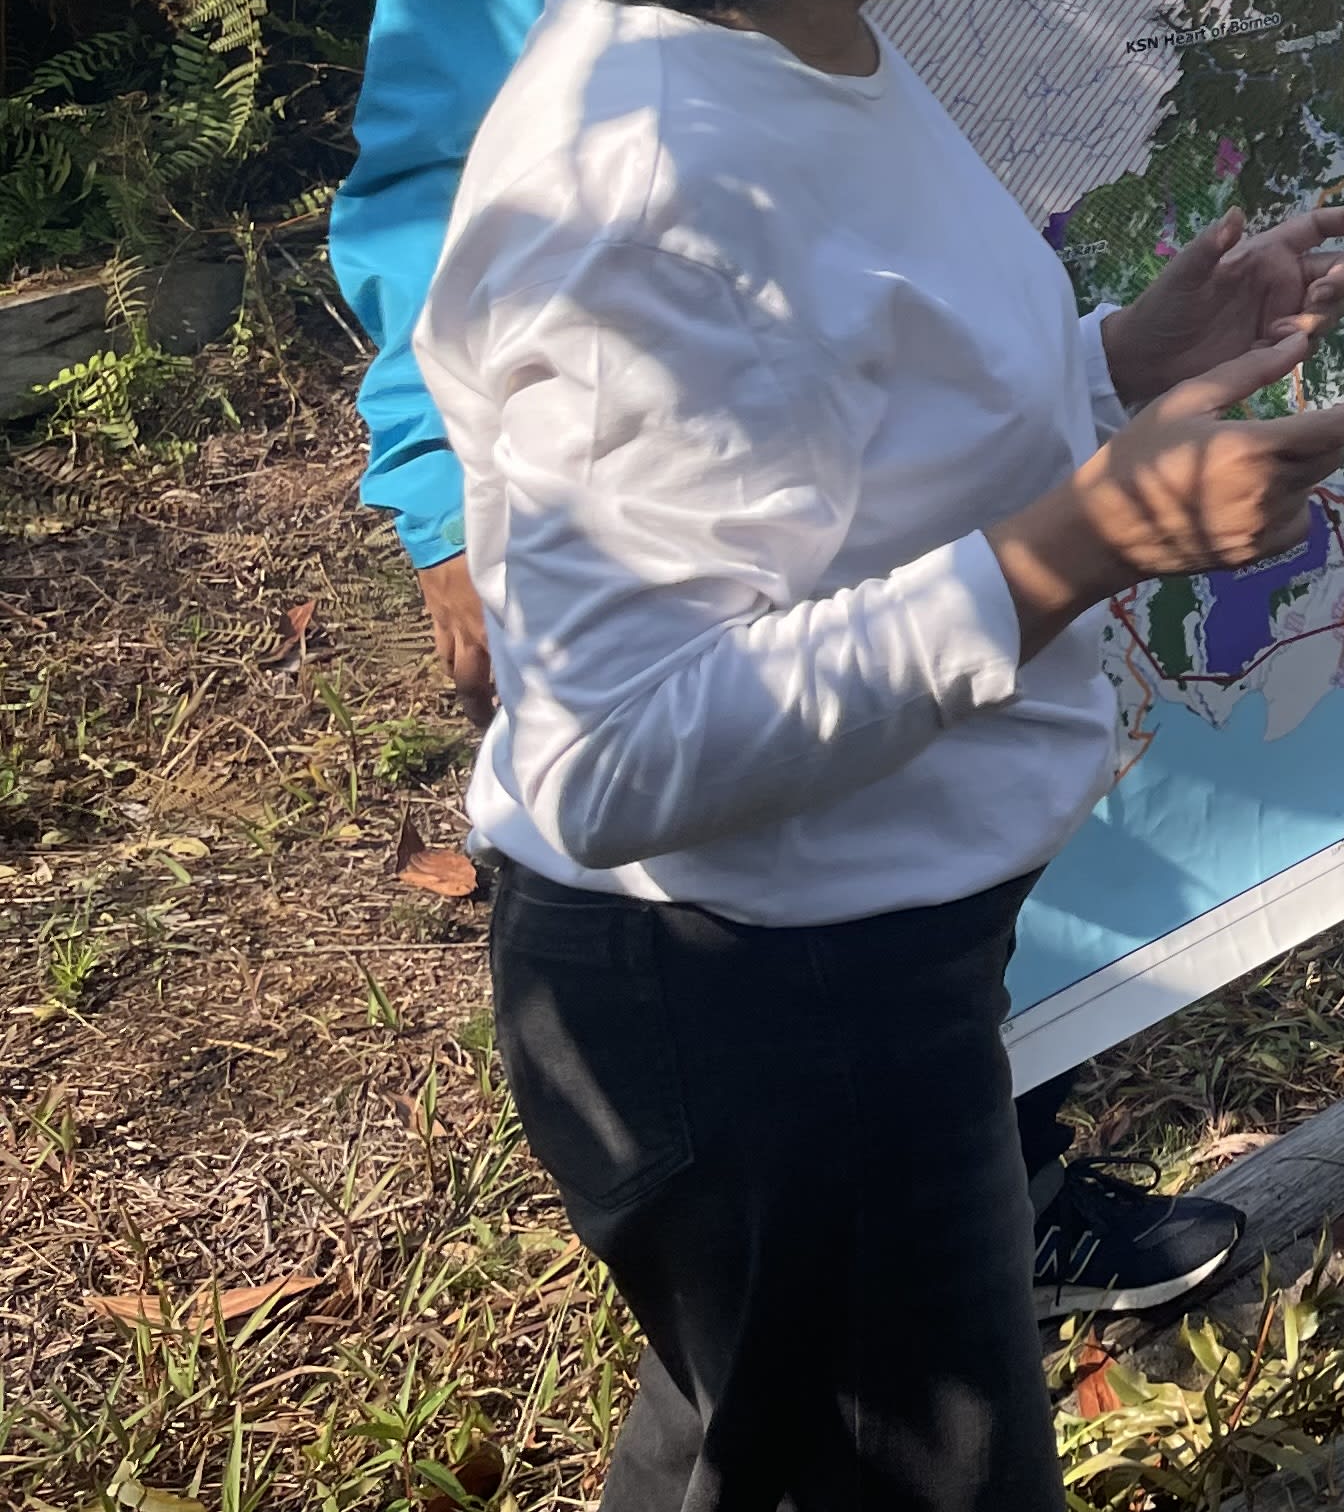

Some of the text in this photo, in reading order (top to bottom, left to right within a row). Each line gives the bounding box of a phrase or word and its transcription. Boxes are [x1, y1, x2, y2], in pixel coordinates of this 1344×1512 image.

[1126, 13, 1280, 54] KSN Heart of Borneo
